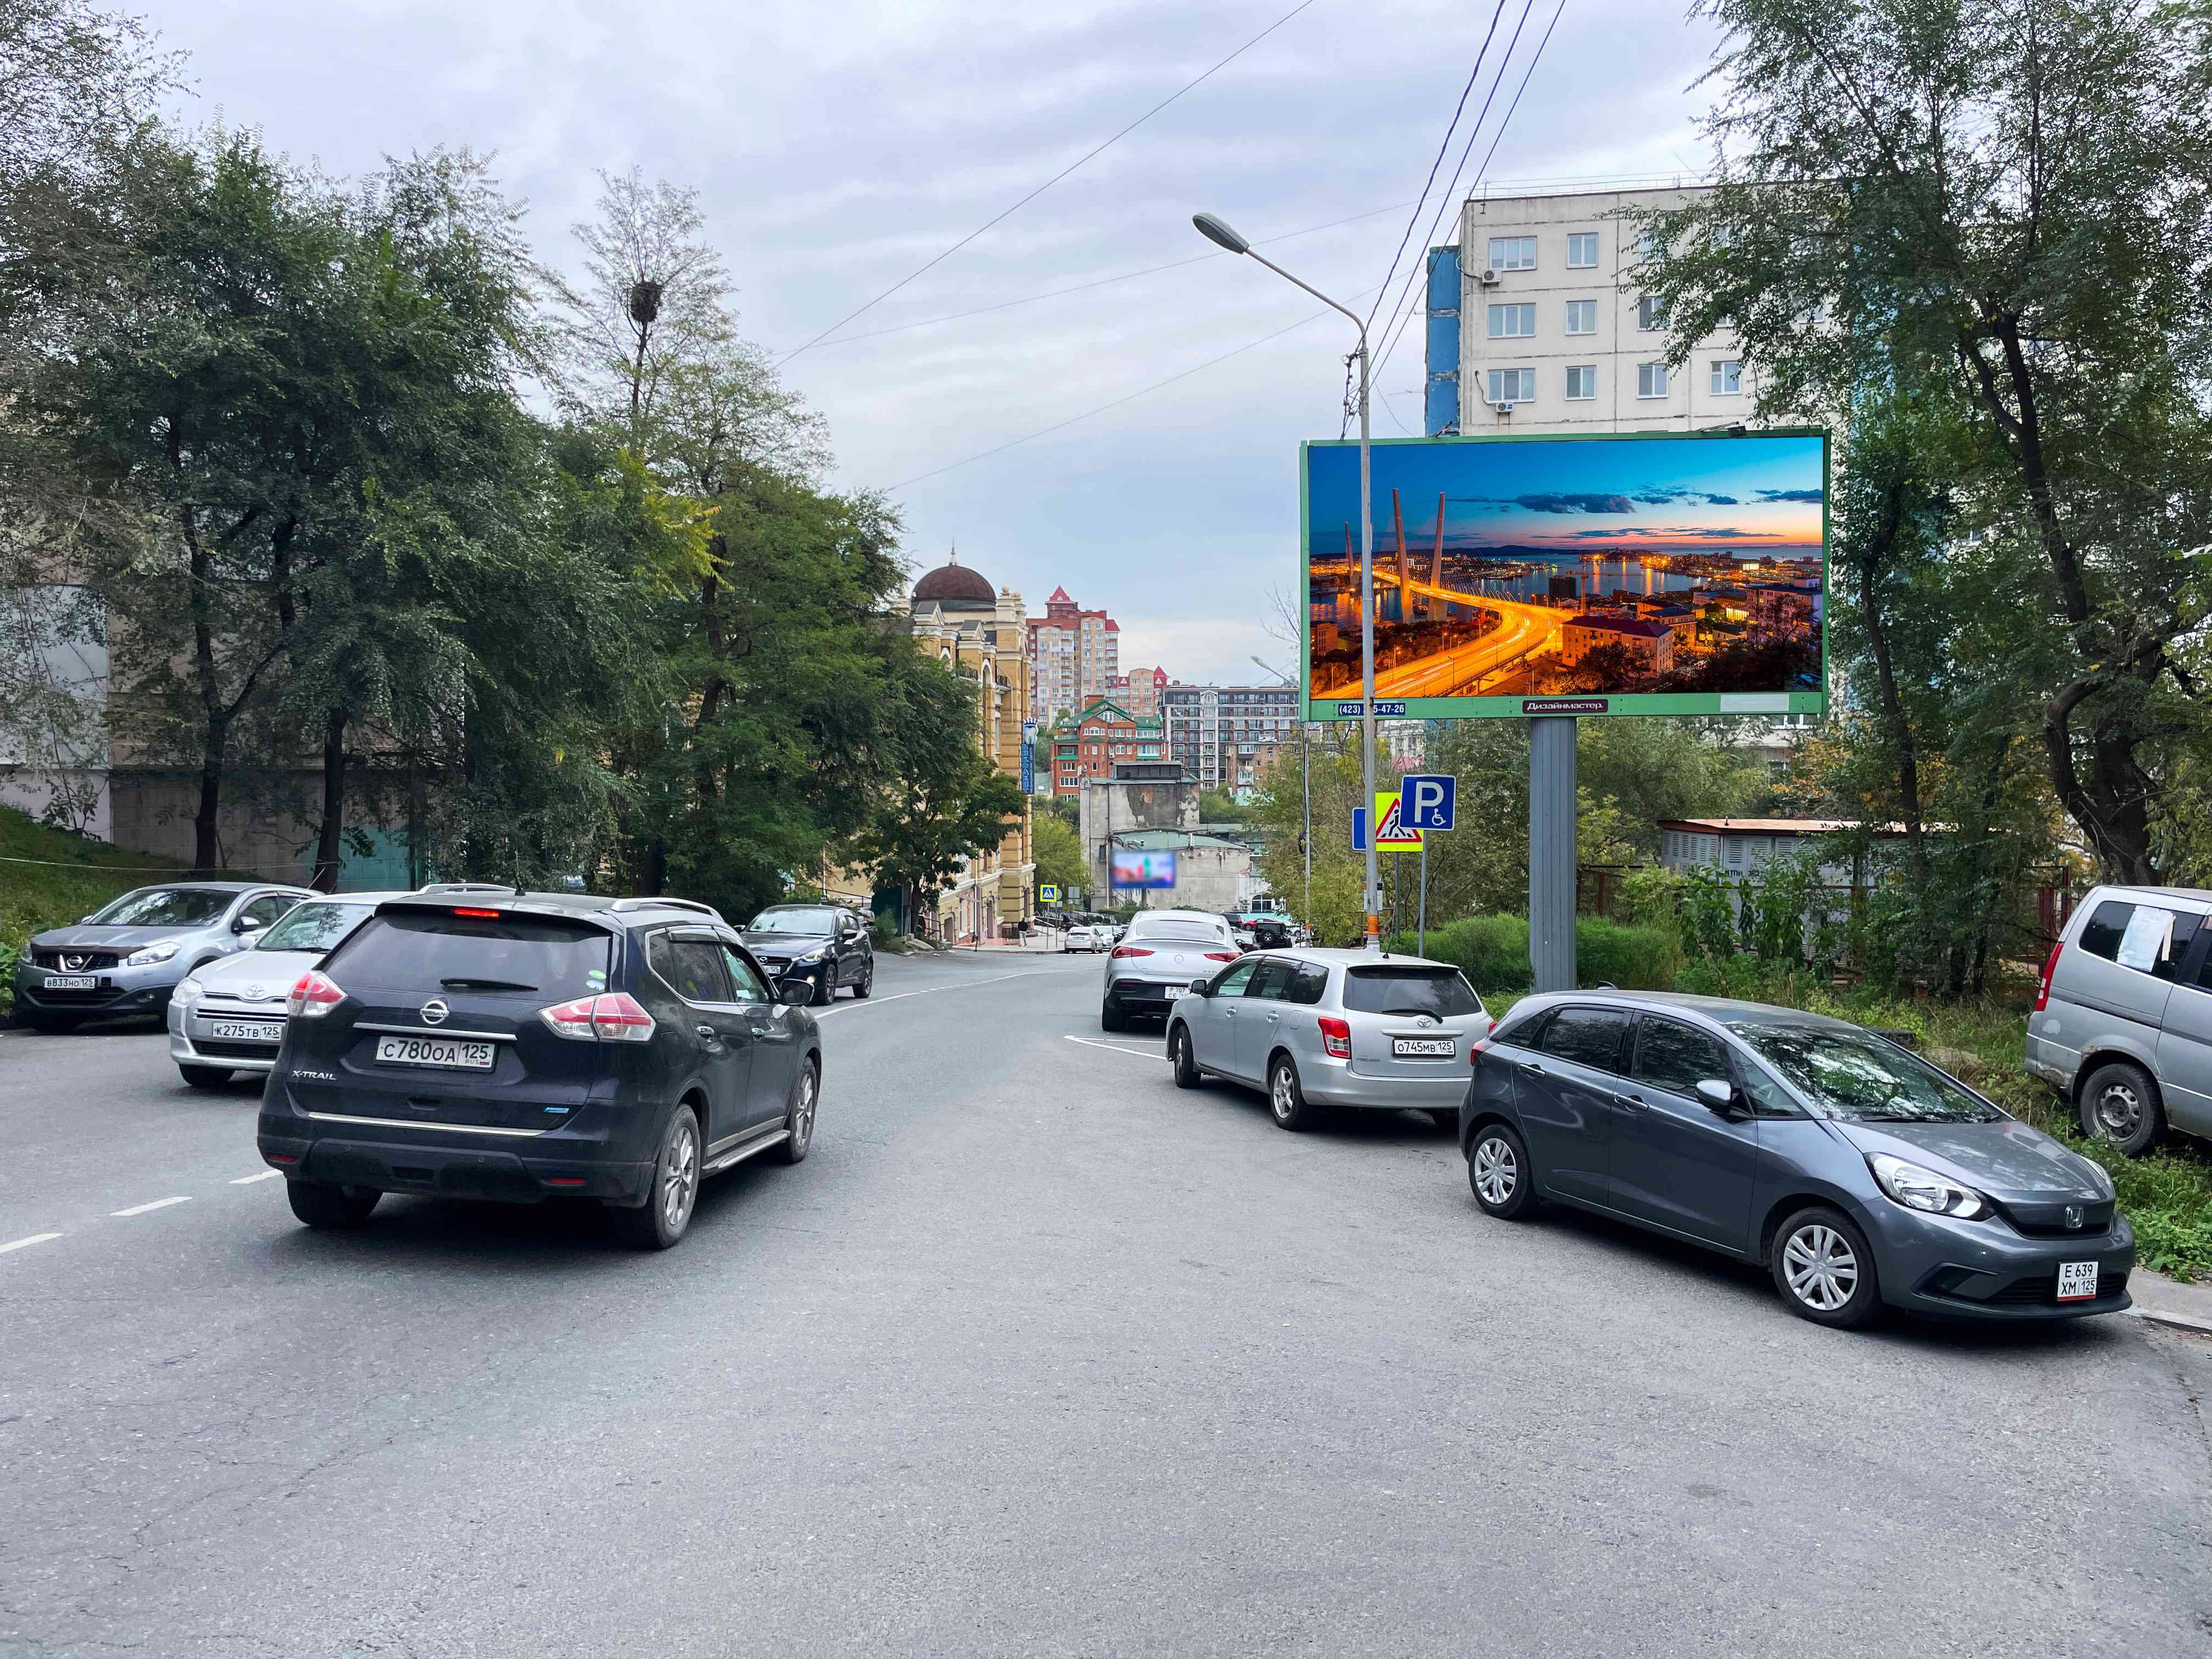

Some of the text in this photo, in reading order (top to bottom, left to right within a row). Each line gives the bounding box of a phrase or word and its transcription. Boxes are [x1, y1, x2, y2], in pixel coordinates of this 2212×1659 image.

[1339, 704, 1361, 715] (423)
[1415, 782, 1444, 823] P
[262, 1027, 278, 1035] 125
[384, 1040, 489, 1062] С780ОА 125
[1438, 1042, 1452, 1050] 125
[291, 1070, 336, 1080] X-TRAIL
[2075, 1264, 2093, 1277] 639
[2081, 1280, 2095, 1290] 125
